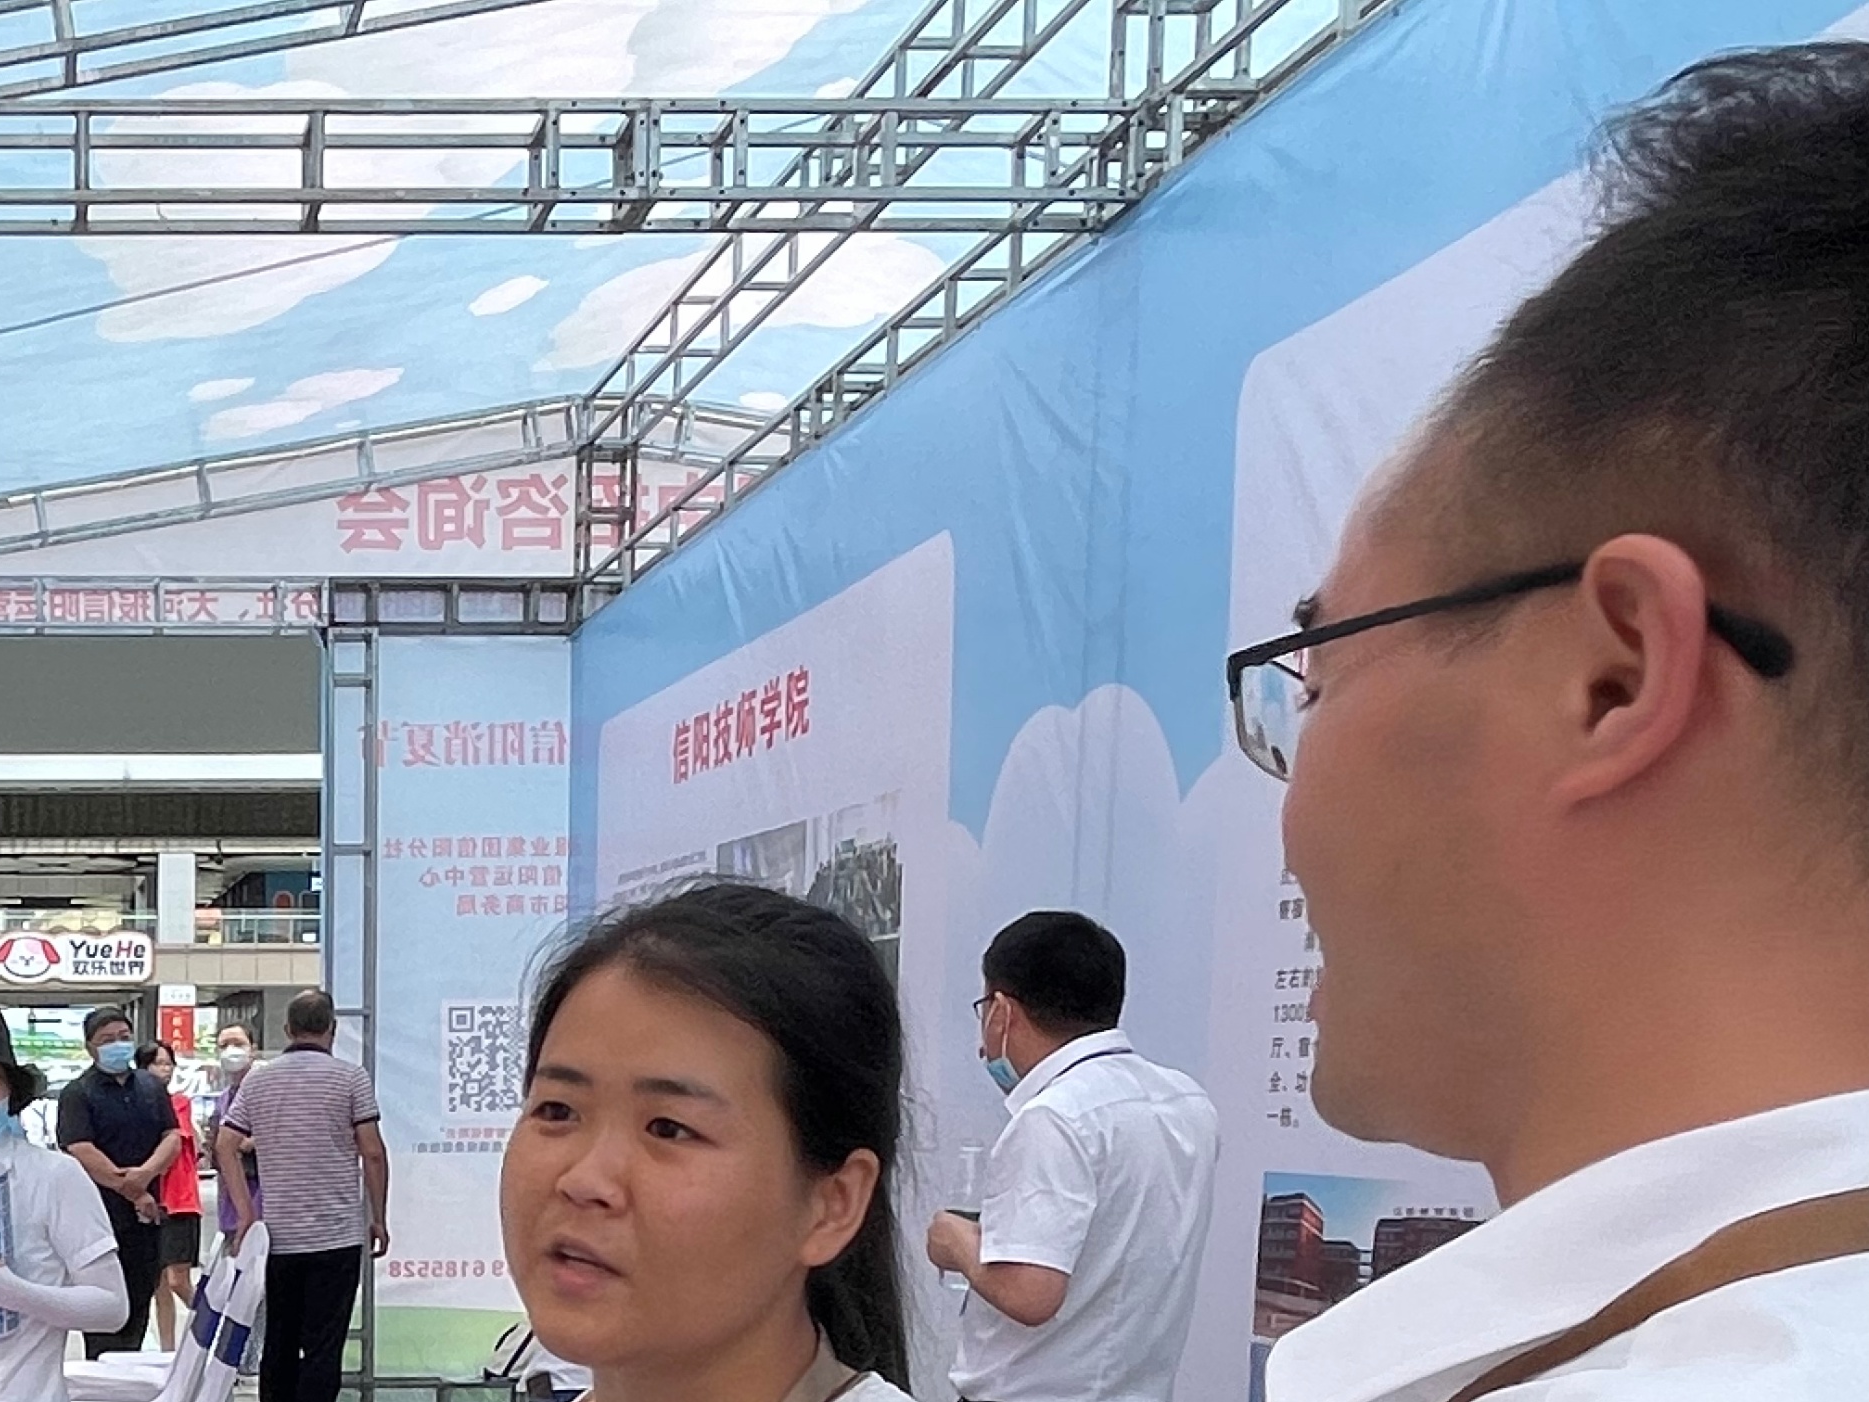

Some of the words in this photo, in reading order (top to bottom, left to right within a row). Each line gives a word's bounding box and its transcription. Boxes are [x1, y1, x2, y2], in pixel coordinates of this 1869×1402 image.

[673, 664, 810, 784] 信阳技师学院
[69, 940, 146, 959] YueHe
[72, 960, 145, 976] 欢乐世界
